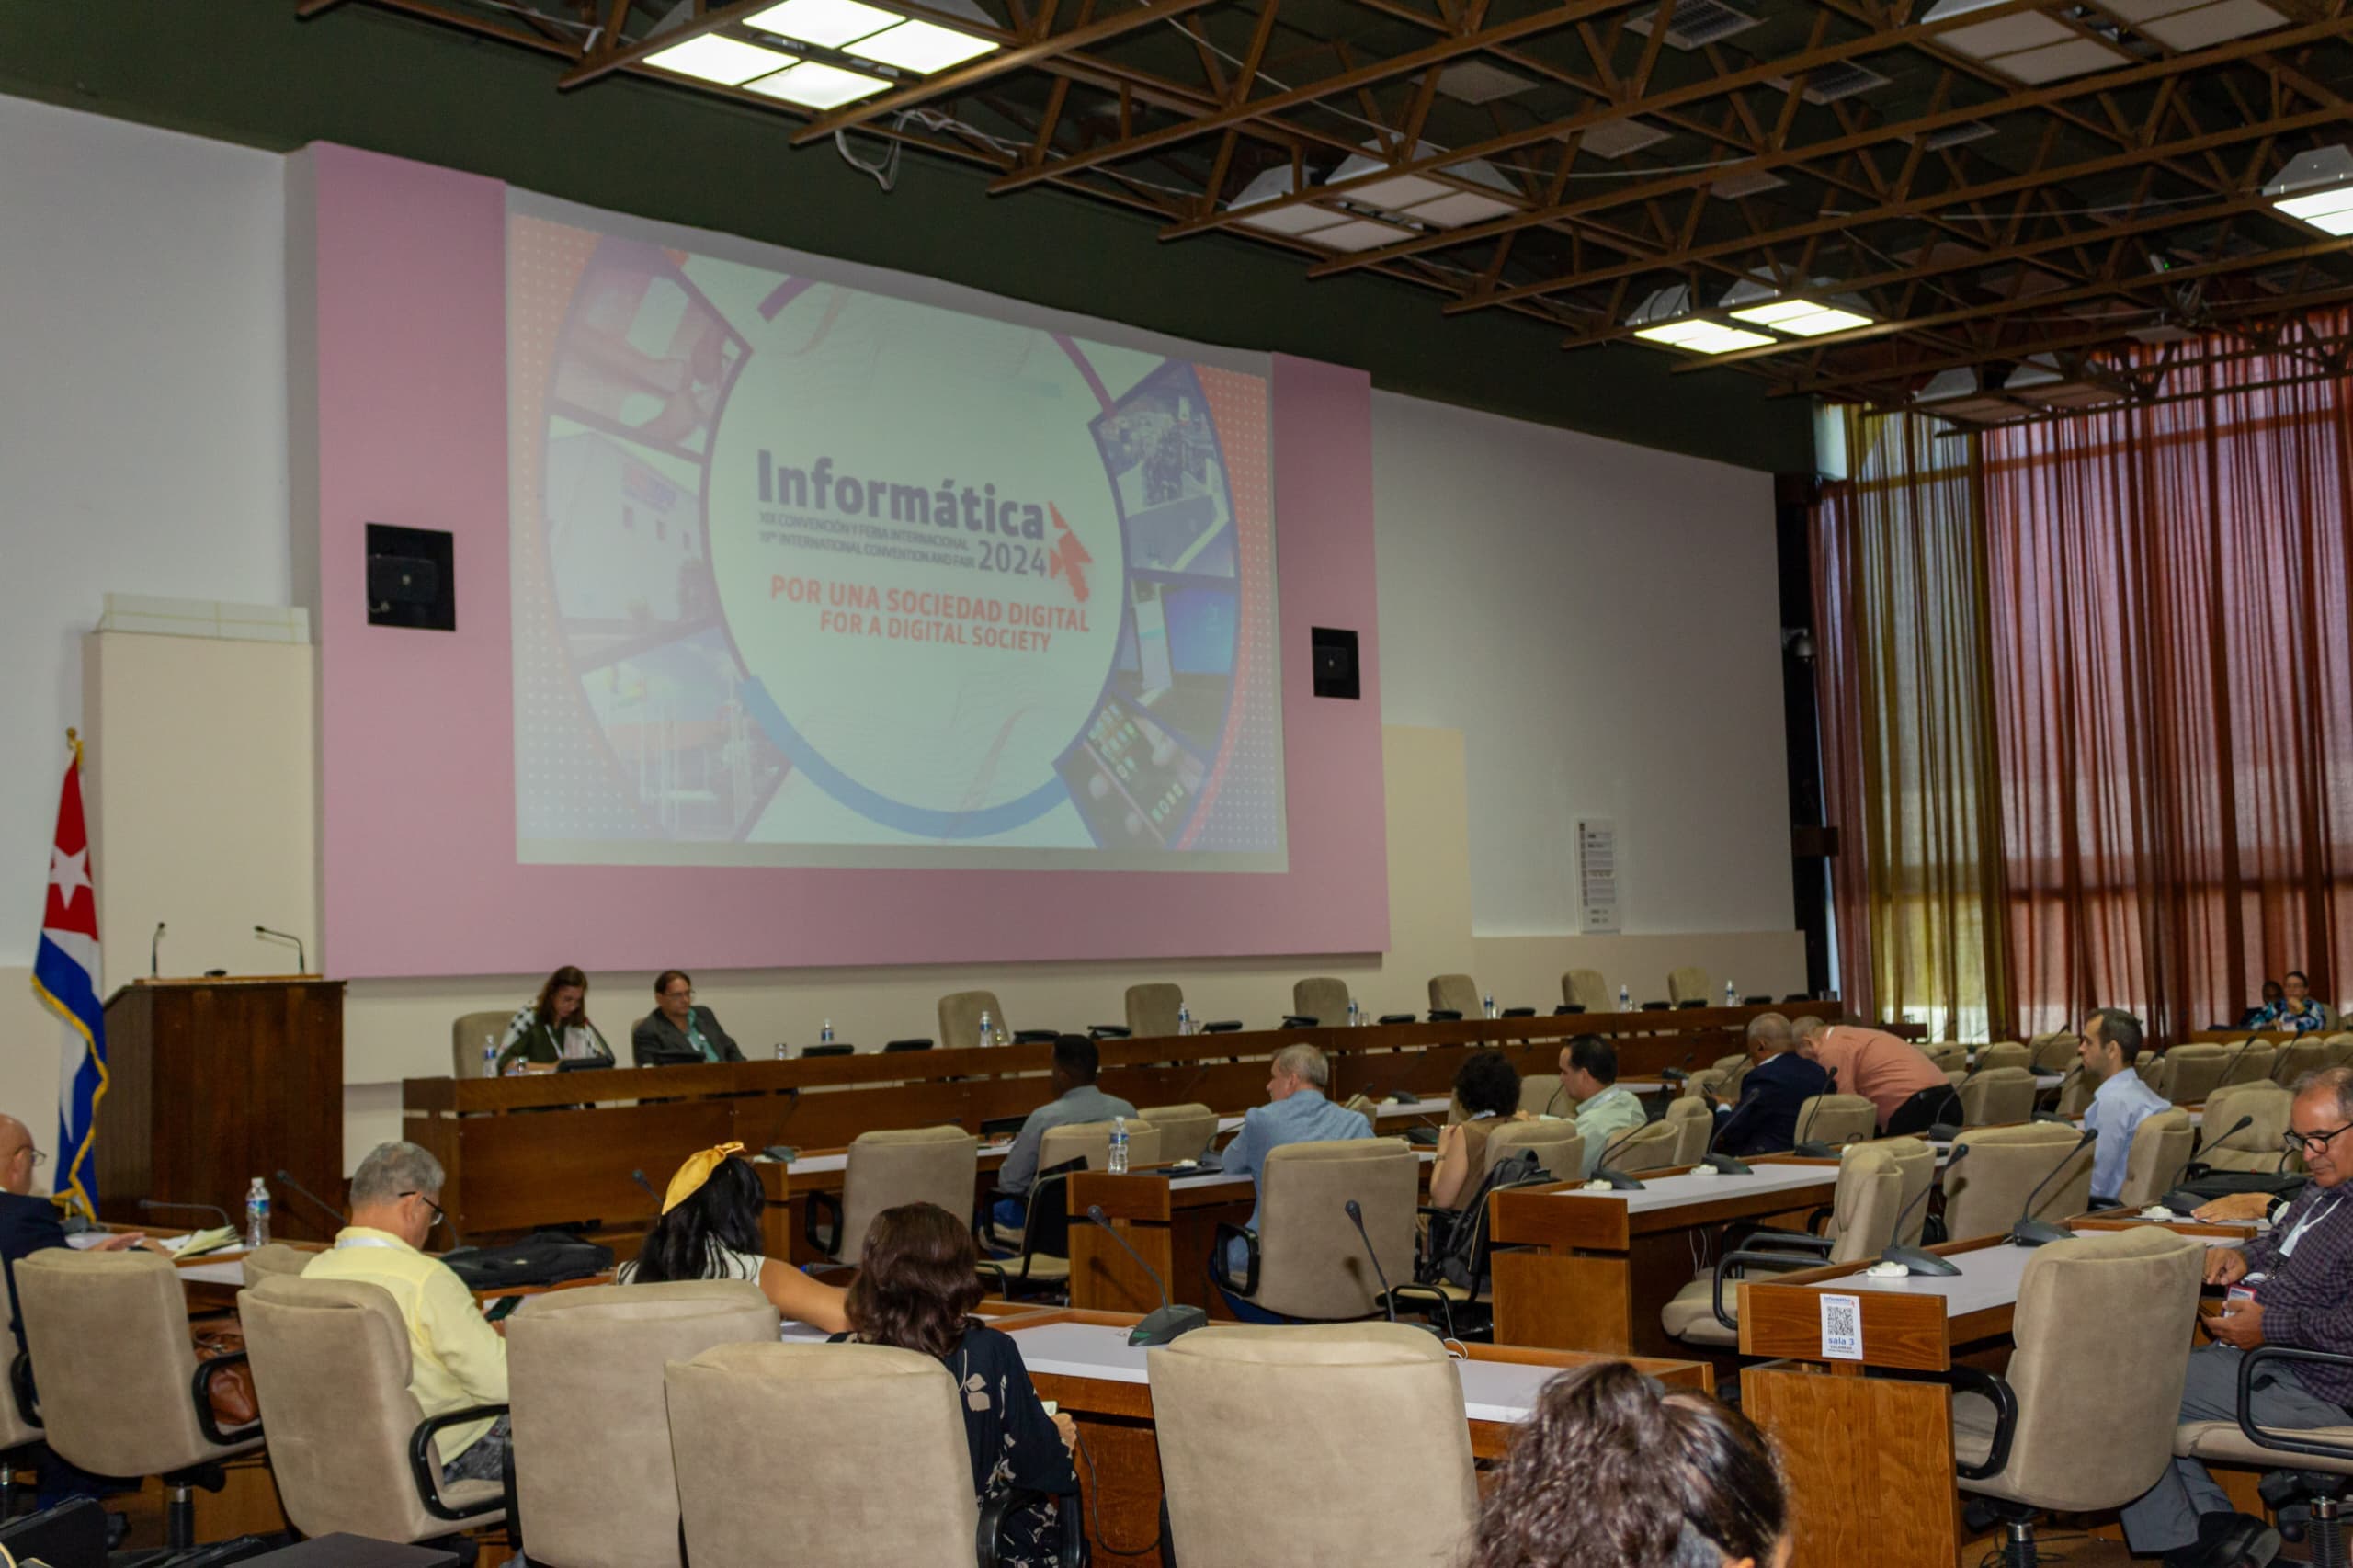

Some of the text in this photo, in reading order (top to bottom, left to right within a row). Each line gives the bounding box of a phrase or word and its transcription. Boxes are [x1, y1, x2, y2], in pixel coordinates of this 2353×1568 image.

[758, 449, 1044, 540] Informática
[779, 533, 862, 556] INTERNATIONAL
[892, 529, 969, 551] INTERNACIONAL
[978, 540, 1046, 576] 2024
[770, 574, 1090, 632] POR UNA SOCIEDAD DIGITAL
[820, 610, 1051, 653] FOR A DIGITAL SOCIETY
[1828, 1337, 1847, 1346] sala
